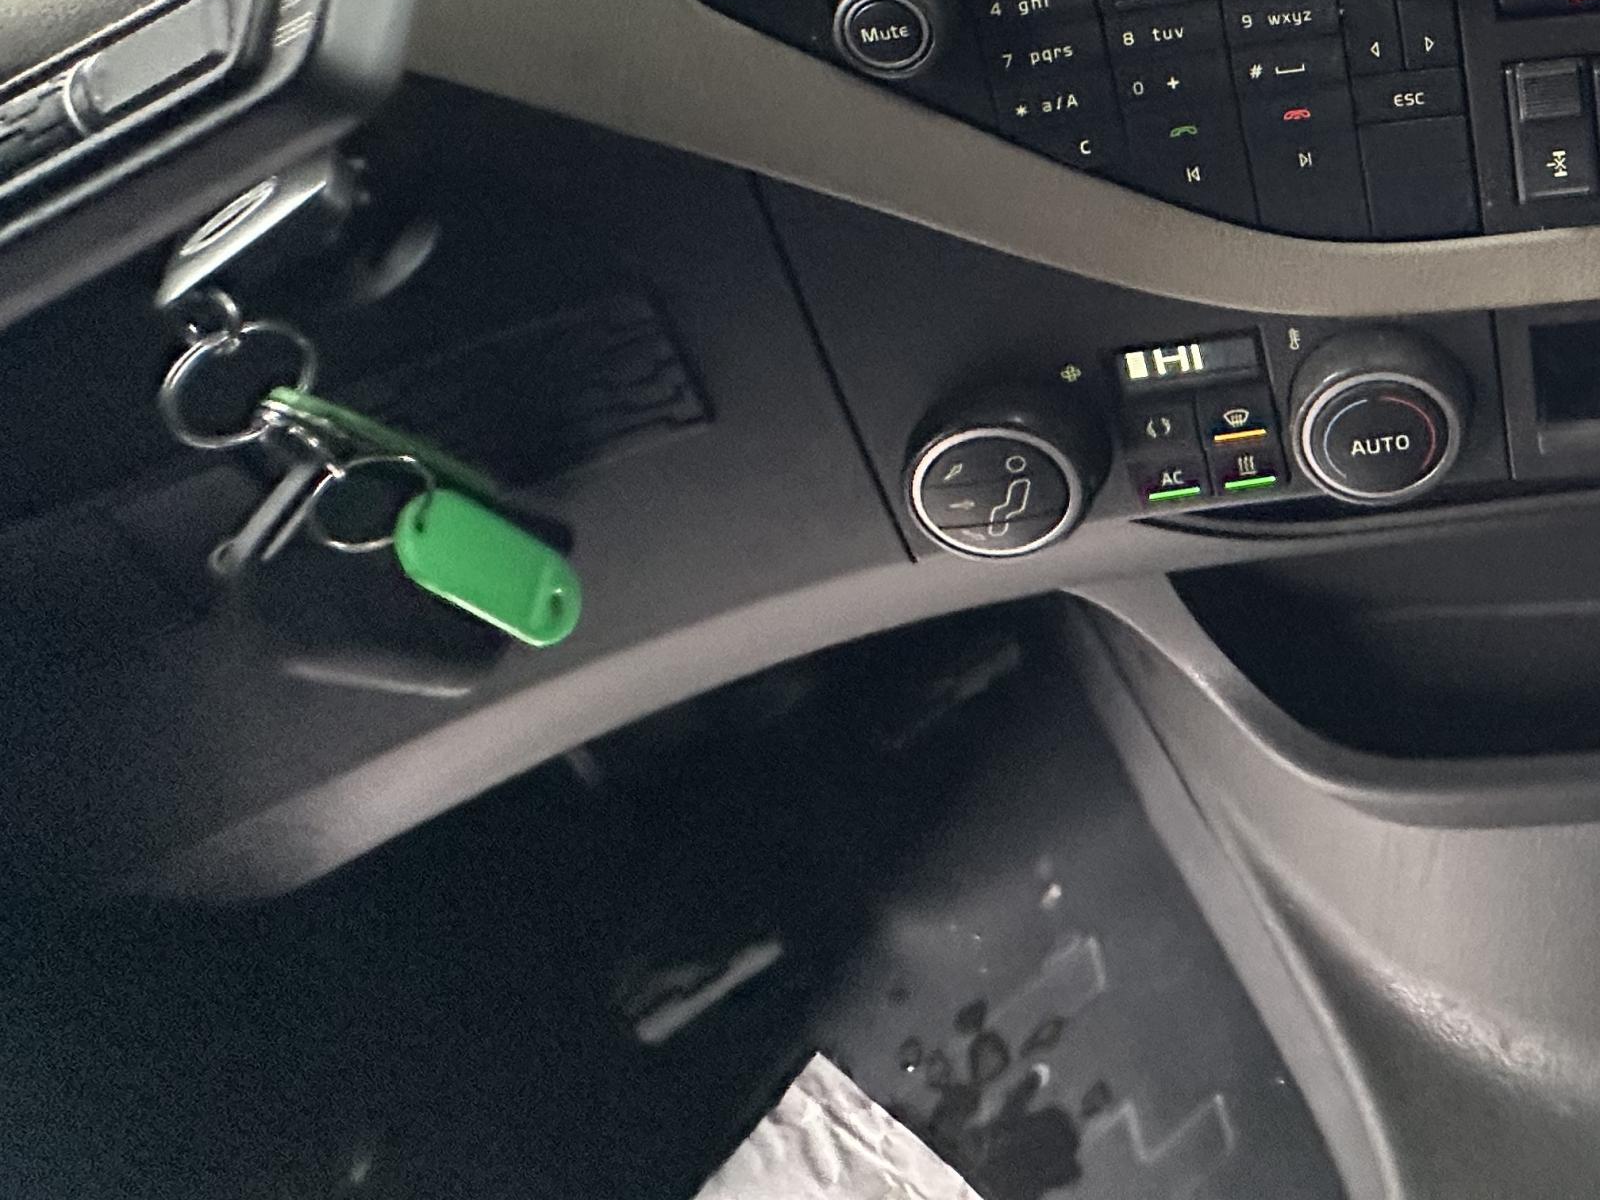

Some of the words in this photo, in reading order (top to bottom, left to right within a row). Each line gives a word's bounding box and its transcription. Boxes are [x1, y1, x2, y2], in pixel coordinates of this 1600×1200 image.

[990, 2, 1002, 16] 4
[1241, 14, 1253, 29] 9
[1267, 10, 1312, 26] wxyz
[860, 25, 908, 43] Mute
[1122, 31, 1135, 46] 8
[1152, 27, 1184, 42] tuv
[1002, 53, 1013, 68] 7
[1030, 45, 1073, 66] pqrs
[1132, 81, 1144, 96] 0
[1393, 92, 1425, 107] ESC
[1080, 140, 1092, 155] C
[1350, 434, 1410, 457] AUTO
[1162, 470, 1184, 486] AC
